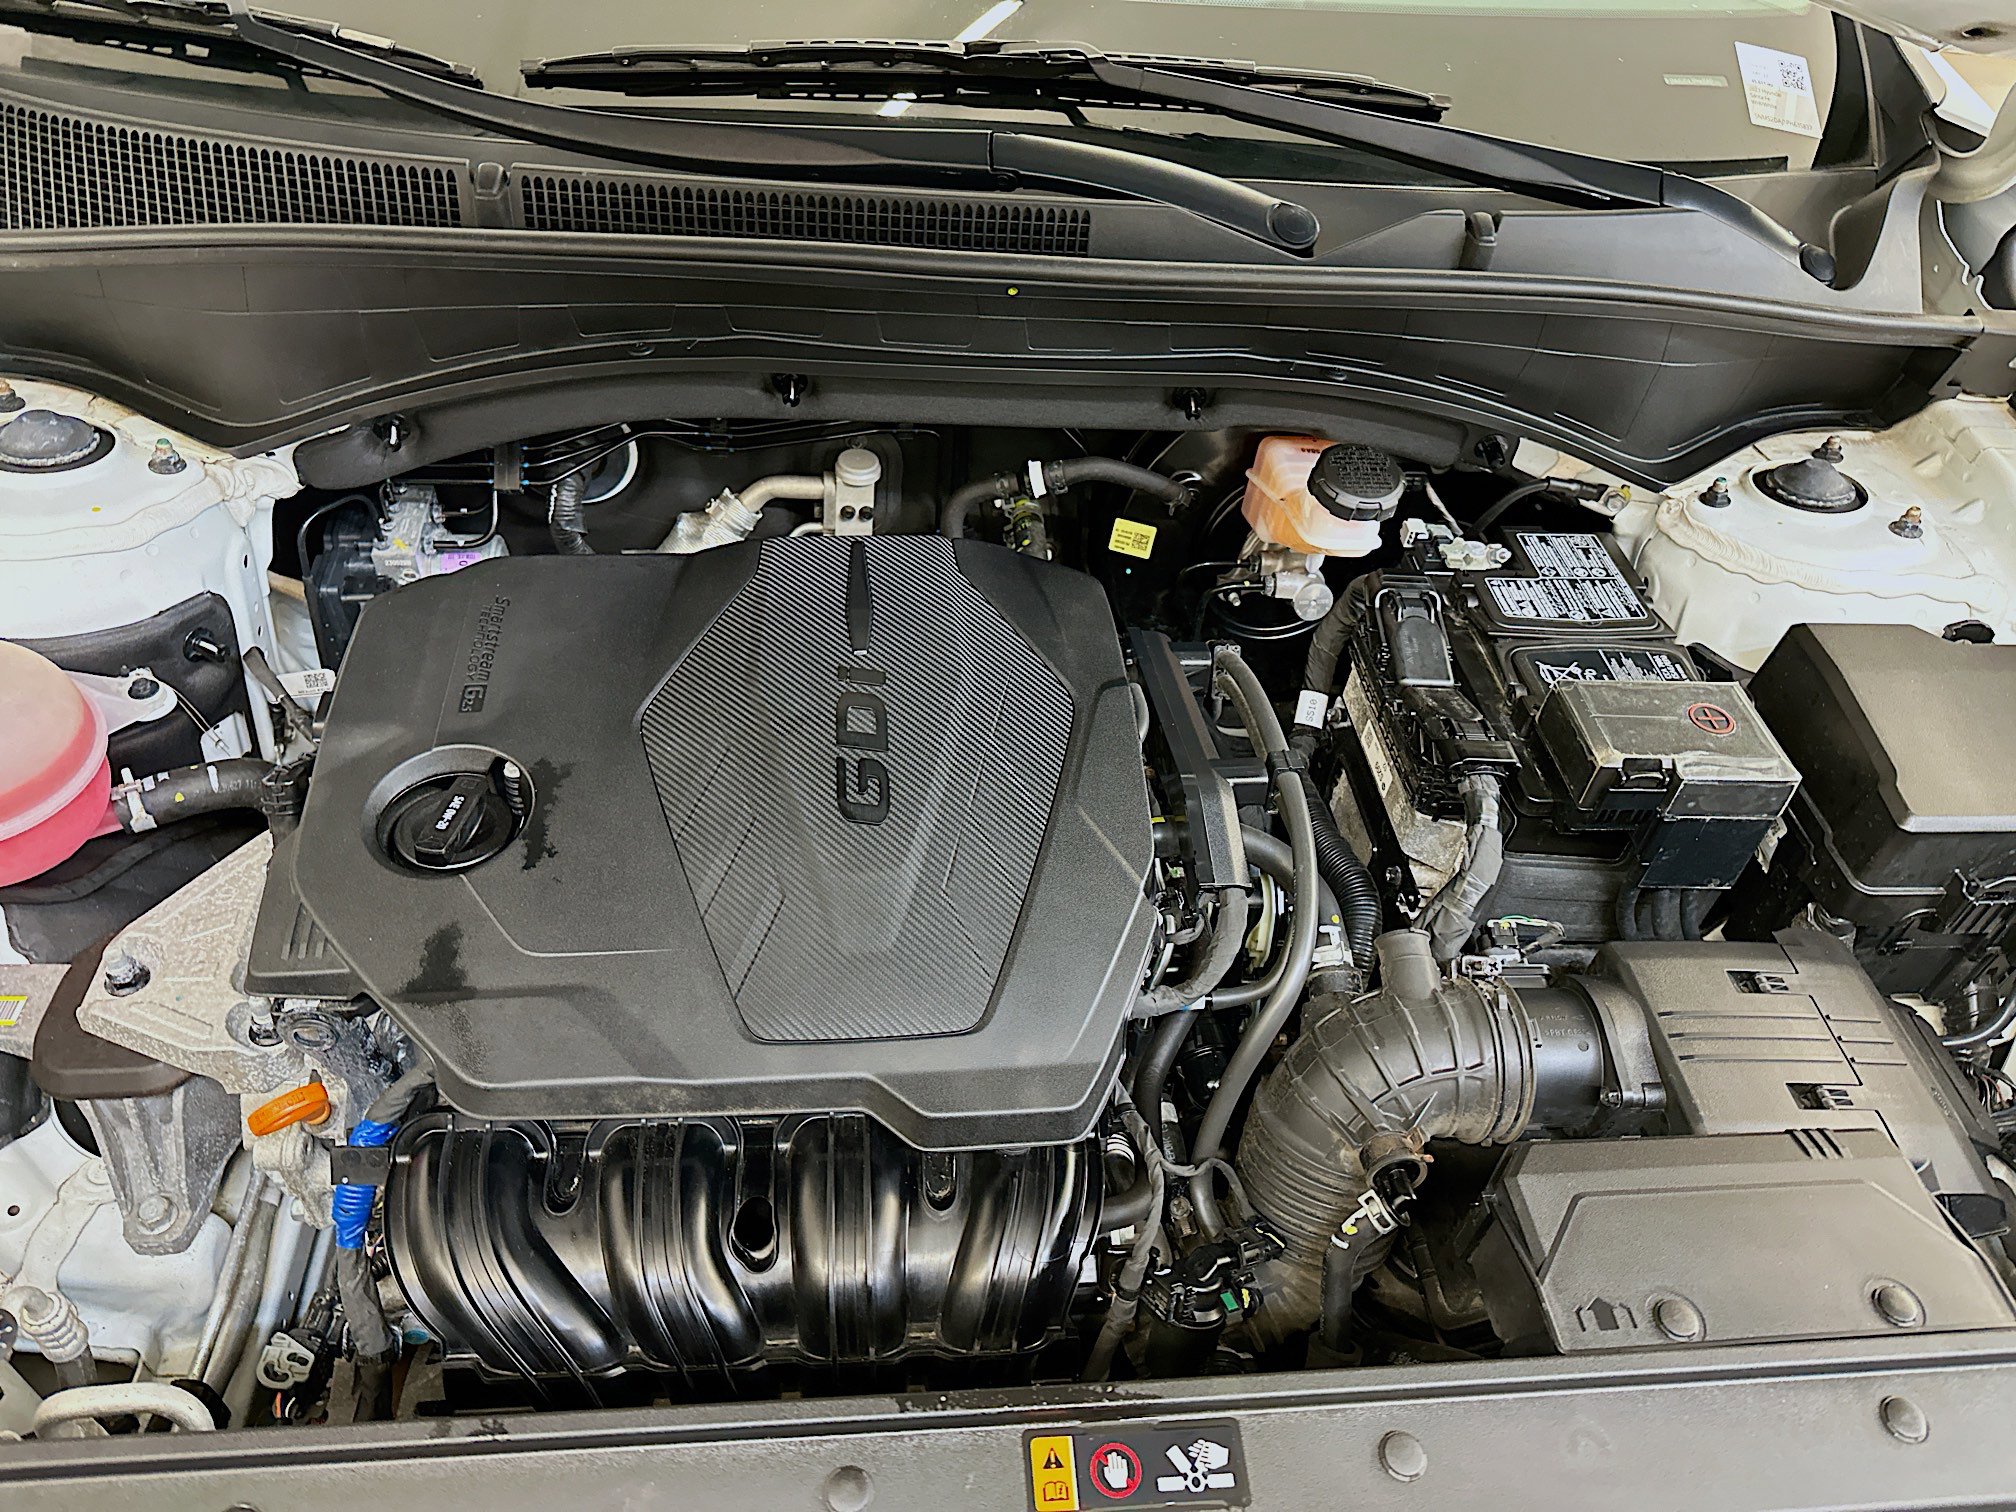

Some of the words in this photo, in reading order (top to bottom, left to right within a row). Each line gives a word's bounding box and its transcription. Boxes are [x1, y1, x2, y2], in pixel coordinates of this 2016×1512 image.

[465, 602, 493, 682] TECHNOLOGY
[477, 596, 511, 682] Smartstream
[835, 664, 891, 827] GDi
[448, 795, 465, 810] SAE
